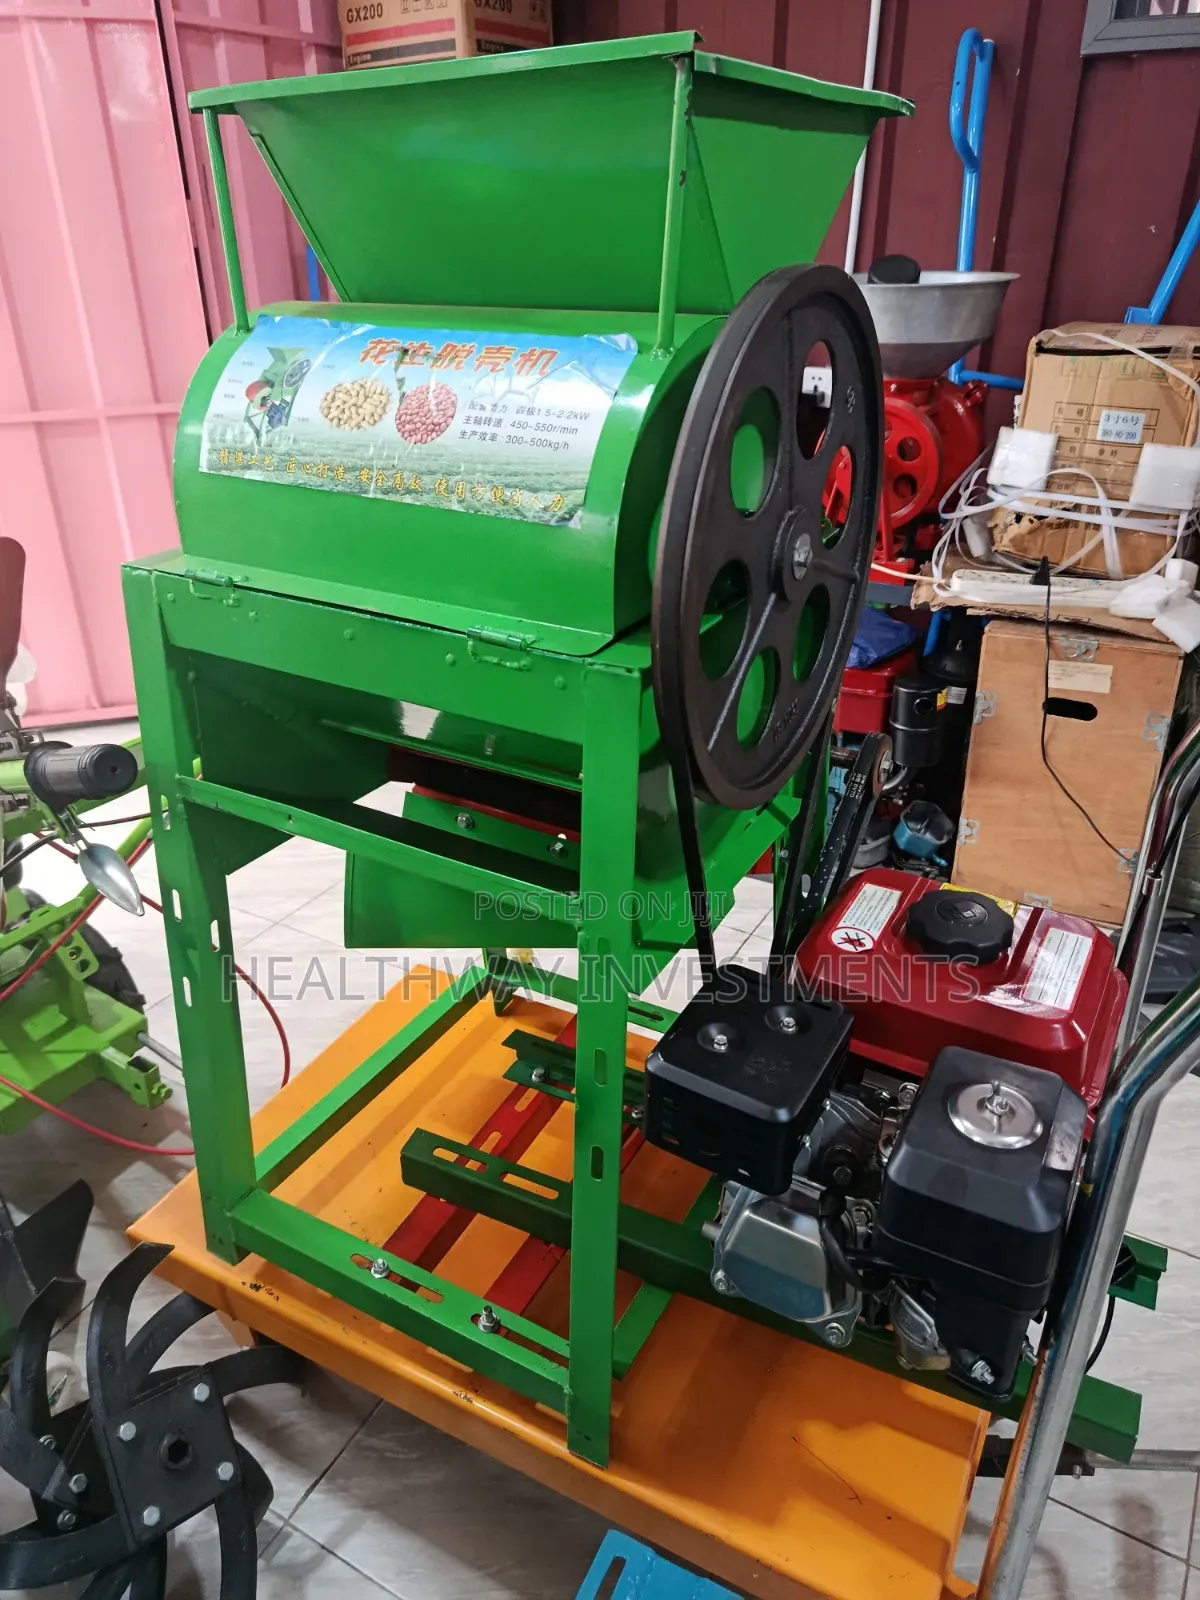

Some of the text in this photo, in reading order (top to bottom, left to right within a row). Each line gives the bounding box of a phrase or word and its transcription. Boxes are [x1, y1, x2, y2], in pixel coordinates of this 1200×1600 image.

[346, 5, 384, 24] GX200
[359, 338, 561, 376] 花生脱壳机
[515, 405, 590, 421] 四极15-2.2kW
[286, 457, 348, 483] 匠心打造
[357, 467, 424, 493] 安全高效
[434, 475, 566, 513] 使用方便省人力
